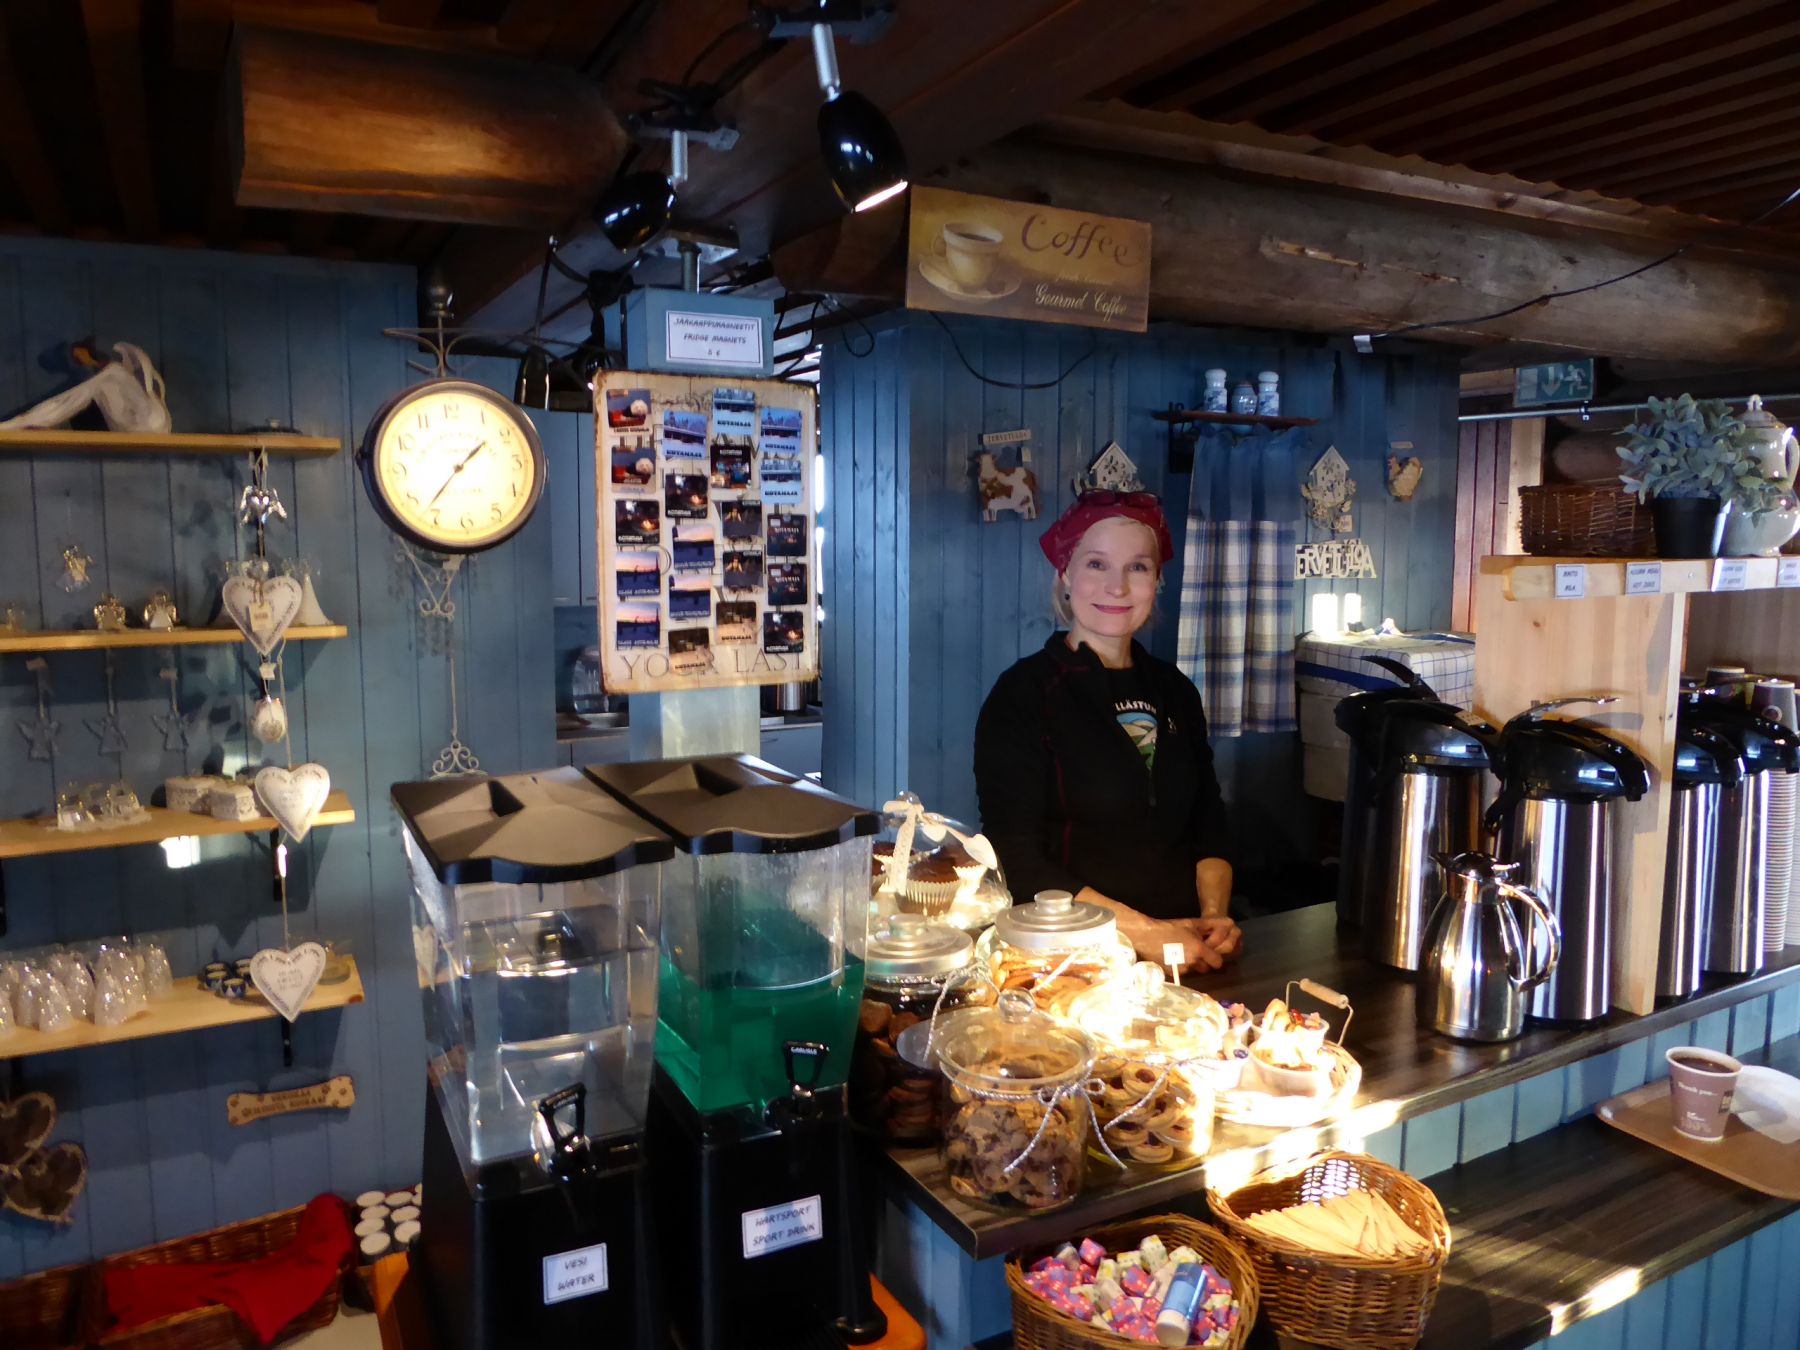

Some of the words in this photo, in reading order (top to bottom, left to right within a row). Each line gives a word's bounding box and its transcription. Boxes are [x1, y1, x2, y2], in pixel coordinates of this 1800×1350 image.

[1021, 213, 1141, 268] Coffee
[683, 333, 709, 342] FRIDGE
[711, 335, 747, 344] MAGNETS
[755, 1205, 812, 1226] HARTSPORT
[752, 1231, 785, 1246] SPORT
[786, 1224, 815, 1237] DRINK
[558, 1273, 595, 1290] WATER
